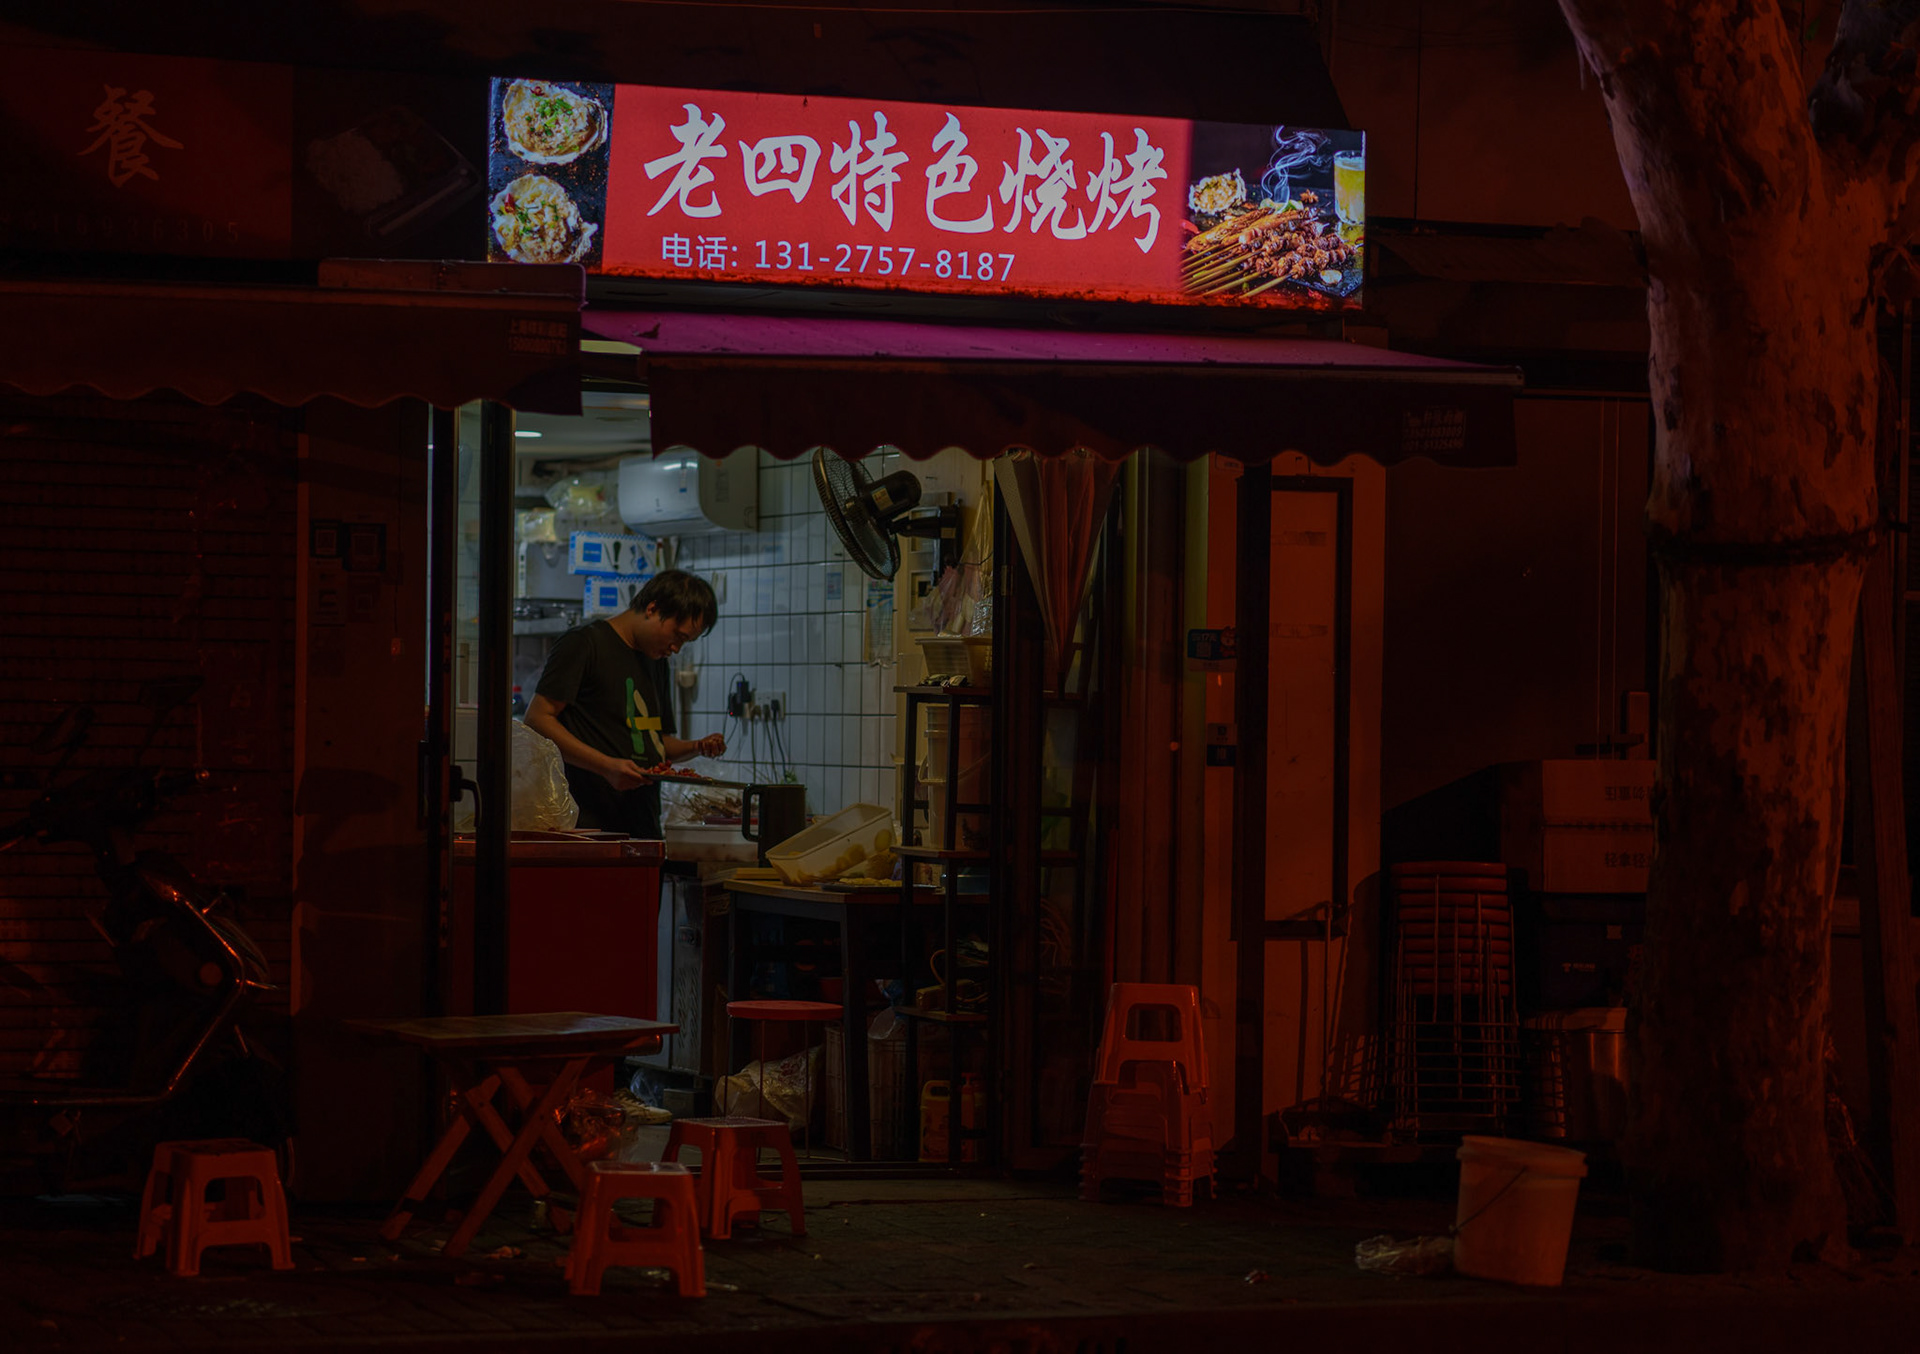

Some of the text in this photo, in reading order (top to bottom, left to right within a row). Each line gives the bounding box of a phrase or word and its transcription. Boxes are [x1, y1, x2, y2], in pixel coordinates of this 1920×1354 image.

[76, 83, 185, 188] 餐
[643, 102, 1168, 254] 老四特色烧烤
[754, 240, 1016, 282] 131-2757-8187
